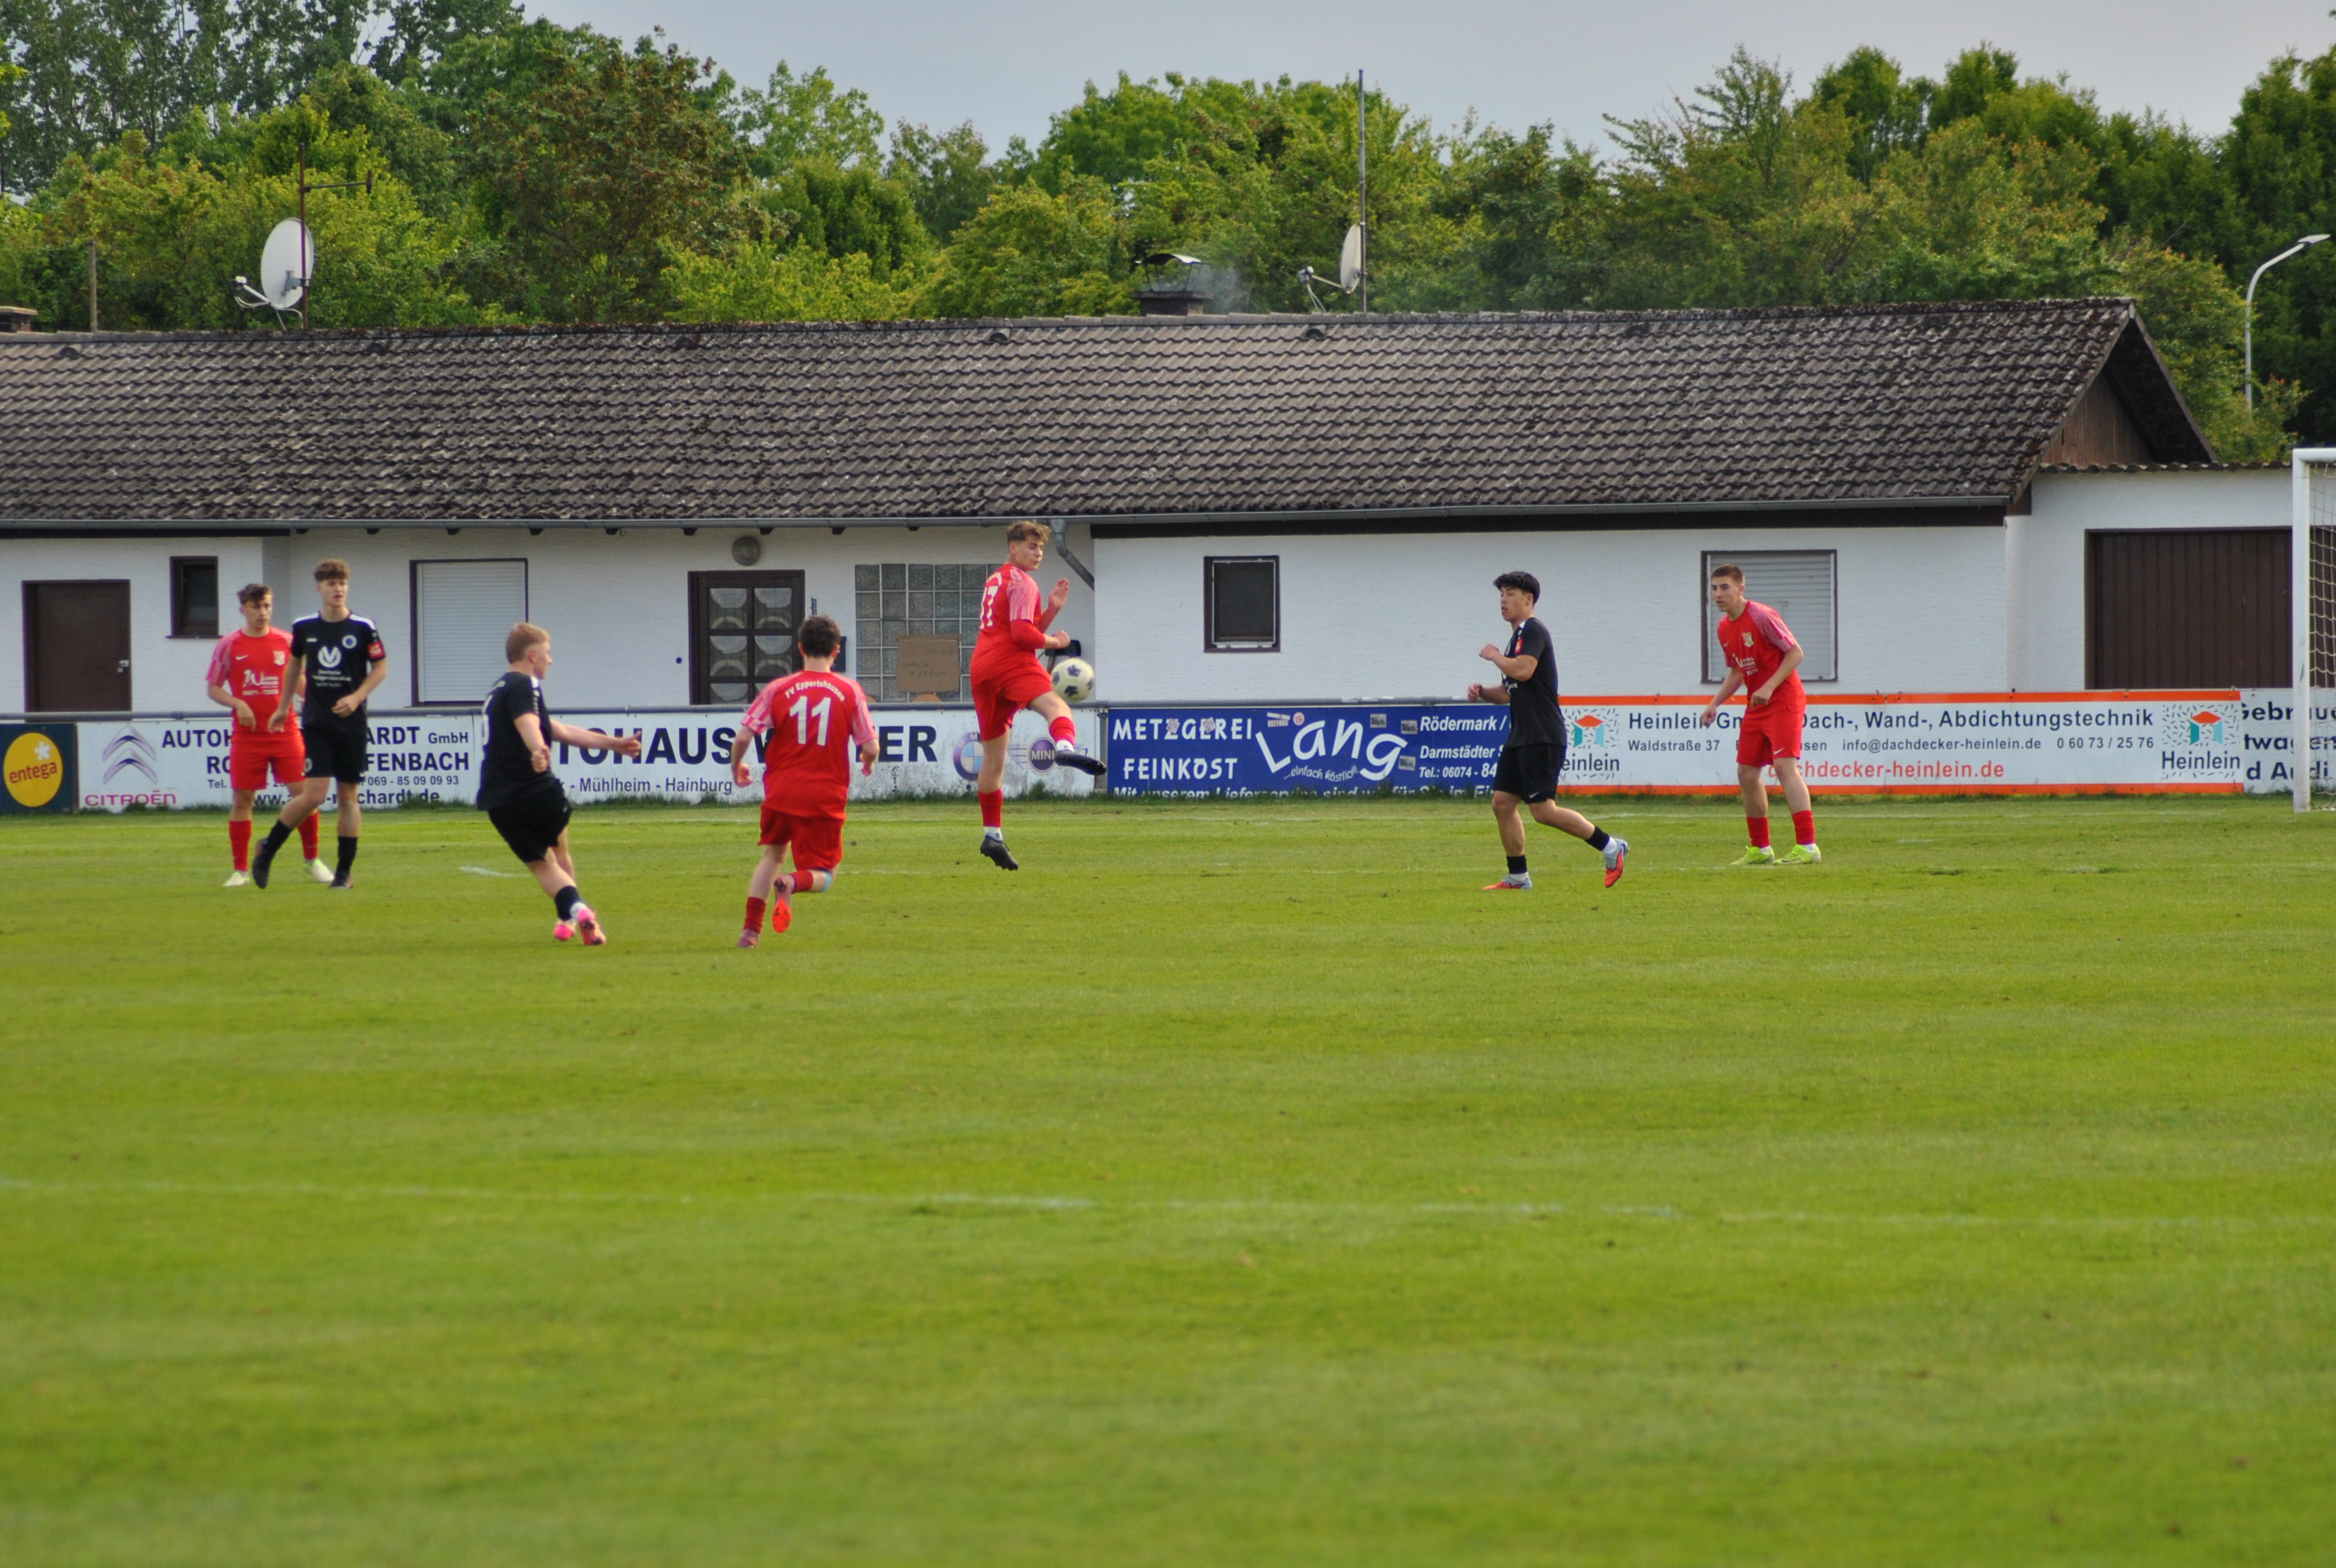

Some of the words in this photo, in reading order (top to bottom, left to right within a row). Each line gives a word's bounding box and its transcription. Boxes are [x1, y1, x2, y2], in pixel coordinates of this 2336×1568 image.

[785, 686, 795, 699] FV
[790, 695, 832, 746] 11
[1420, 716, 1497, 732] Rödermark
[1939, 709, 2154, 731] Abdichtungstechnik
[1112, 718, 1252, 740] METZGEREI
[428, 732, 469, 744] GmbH
[1628, 740, 1701, 752] Waldstraße
[1705, 740, 1720, 752] 37
[1842, 737, 2042, 753] info@dachdecker-heinlein.de
[2068, 737, 2084, 749] 60
[2088, 737, 2104, 749] 73
[2117, 737, 2134, 749] 25
[2138, 736, 2154, 749] 76
[1031, 749, 1055, 761] MINI
[1255, 719, 1408, 782] Lang
[1420, 744, 1496, 760] Darmstädter
[1562, 753, 1620, 771] einlein
[2162, 750, 2241, 769] Heinlein
[9, 761, 57, 784] entega
[1124, 757, 1238, 780] FEINKOST
[1419, 766, 1440, 778] Tel.:
[1442, 766, 1472, 778] 06074
[207, 779, 227, 789] Tel.
[367, 777, 387, 786] 069
[397, 776, 410, 786] 85
[414, 776, 427, 786] 09
[430, 776, 443, 786] 09
[446, 775, 459, 785] 93
[579, 777, 650, 792] Mühlheim
[665, 777, 732, 794] Hainburg
